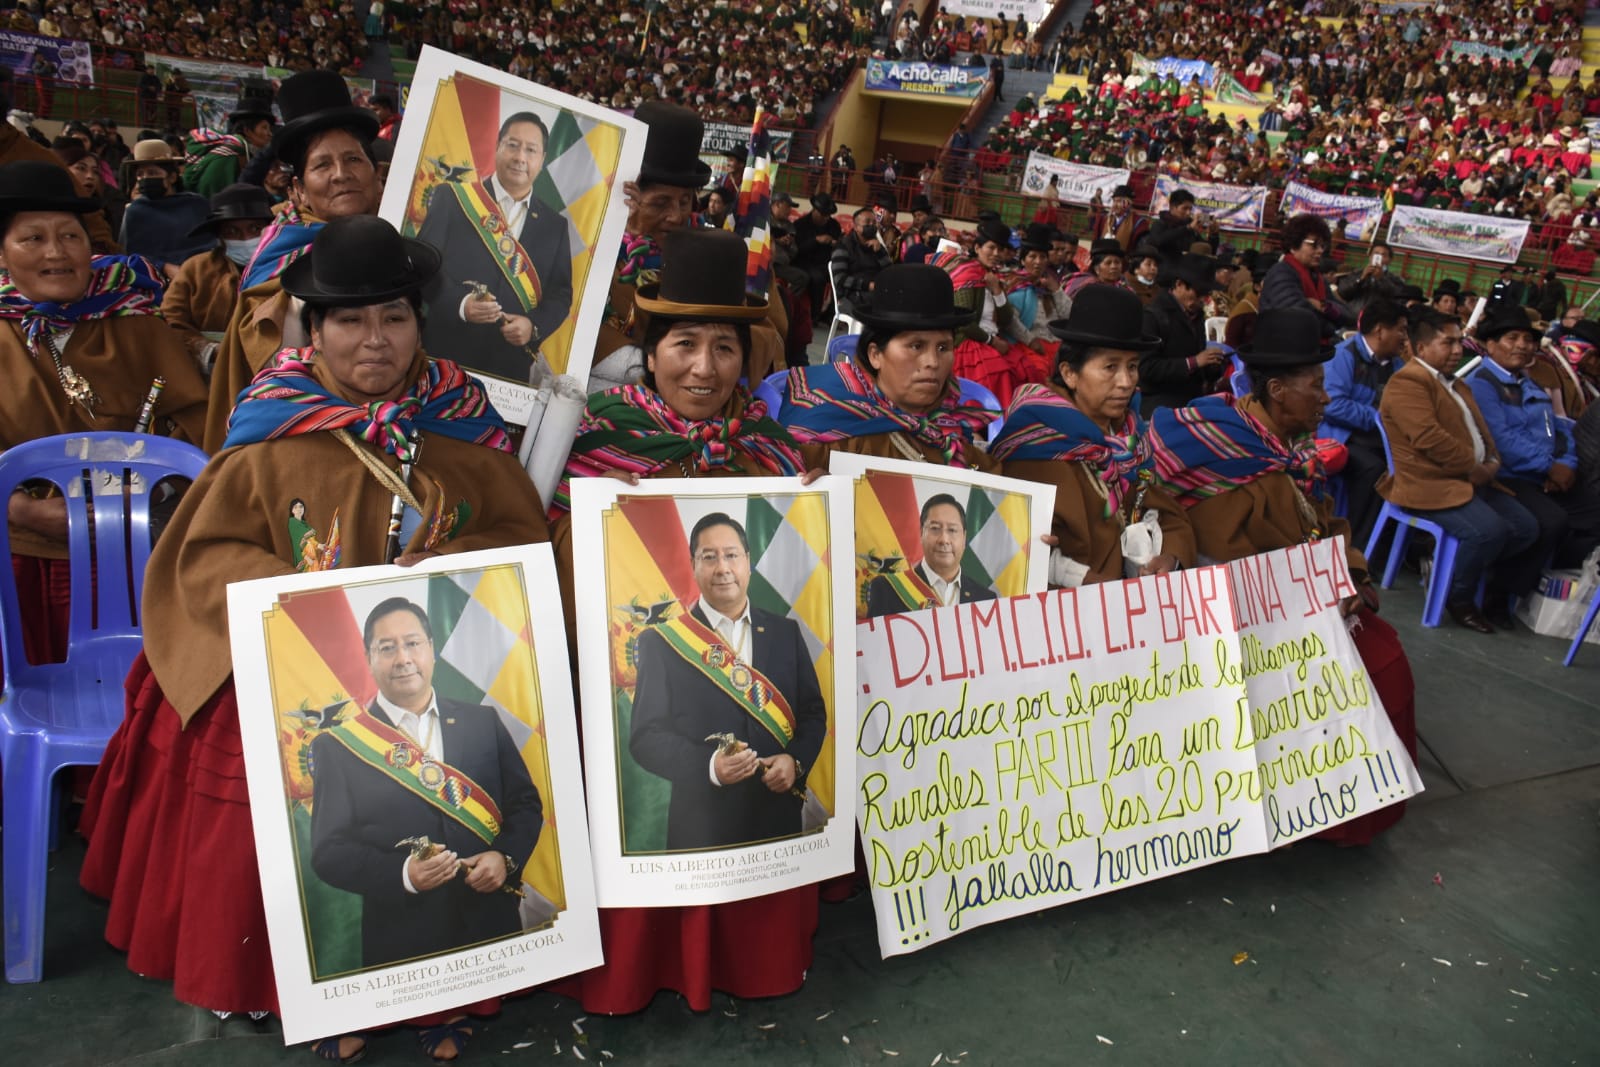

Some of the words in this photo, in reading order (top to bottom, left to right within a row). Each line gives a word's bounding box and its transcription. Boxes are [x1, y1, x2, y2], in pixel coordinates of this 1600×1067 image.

[888, 63, 968, 84] Achocalla
[901, 82, 946, 94] PRESENTE
[1285, 537, 1357, 618] SISA
[857, 681, 1009, 770] Agradece
[1012, 691, 1062, 738] por
[1066, 672, 1088, 718] el
[1088, 650, 1175, 717] proyecto
[1178, 640, 1204, 694] de
[861, 752, 990, 834] Rurales
[994, 731, 1063, 801] PAR
[1108, 712, 1168, 778] Para
[1178, 717, 1221, 763] un
[1056, 790, 1093, 849] de
[1101, 783, 1153, 836] las
[1156, 760, 1204, 822] 20
[629, 862, 664, 875] LUIS
[667, 856, 736, 872] ALBERTO
[738, 850, 772, 866] ARCE
[773, 837, 831, 860] CATACORA
[894, 886, 930, 945] !!!
[1093, 819, 1241, 888] hermano
[1272, 776, 1358, 842] lucho
[1364, 750, 1405, 803] !!!
[674, 883, 689, 891] DEL
[690, 880, 720, 890] ESTADO
[721, 873, 771, 887] PLURINACIONAL
[771, 871, 780, 879] DE
[779, 866, 801, 877] BOLIVIA
[691, 870, 736, 881] PRESIDENTE
[737, 861, 788, 876] CONSTITUCIONAL
[323, 983, 361, 1001] LUIS
[365, 966, 440, 992] ALBERTO
[444, 953, 485, 975] ARCE
[487, 932, 565, 962] CATACORA
[375, 999, 391, 1009] DEL
[392, 991, 424, 1005] ESTADO
[425, 977, 485, 999] PLURINACIONAL
[486, 975, 497, 984] DE
[497, 966, 526, 980] BOLIVIA
[392, 980, 442, 996] PRESIDENTE
[443, 963, 507, 986] CONSTITUCIONAL
